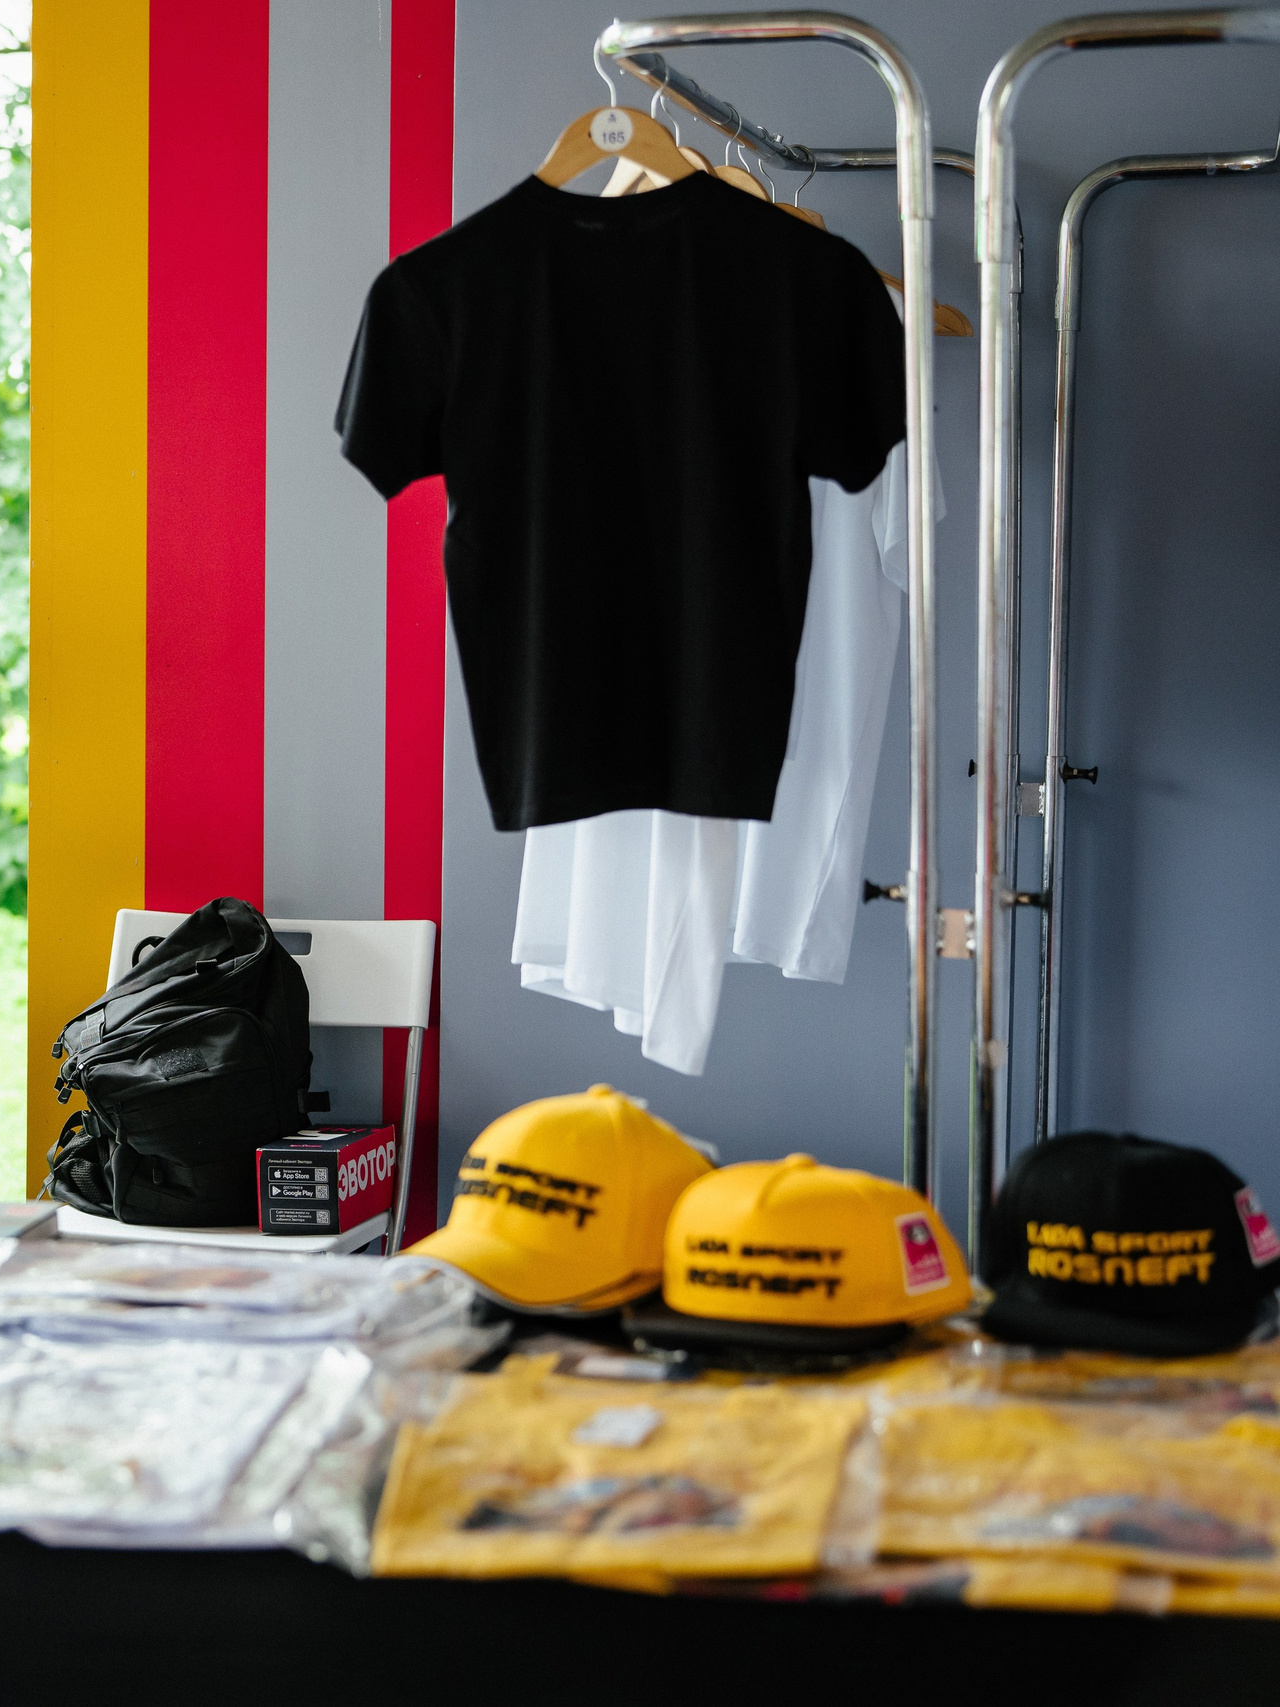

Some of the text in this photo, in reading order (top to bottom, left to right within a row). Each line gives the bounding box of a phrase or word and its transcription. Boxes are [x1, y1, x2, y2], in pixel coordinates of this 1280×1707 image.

[602, 131, 625, 144] 165
[338, 1140, 396, 1201] ЭВОТОР
[496, 1162, 601, 1199] SPORT
[1026, 1220, 1214, 1254] LADA SPORT
